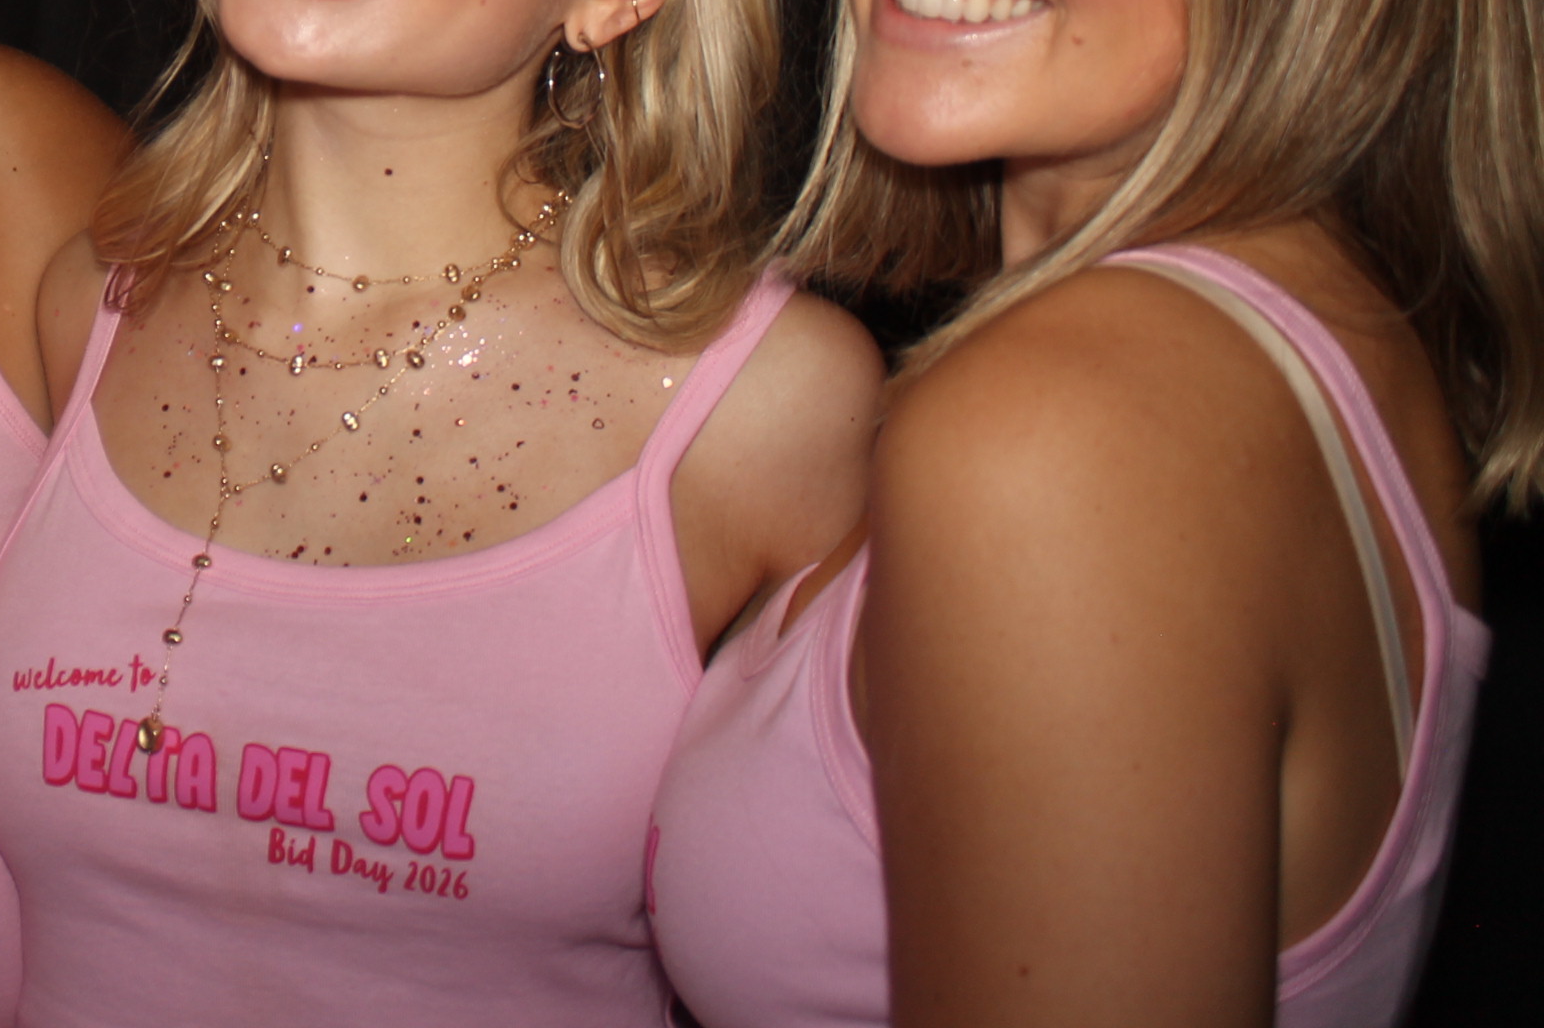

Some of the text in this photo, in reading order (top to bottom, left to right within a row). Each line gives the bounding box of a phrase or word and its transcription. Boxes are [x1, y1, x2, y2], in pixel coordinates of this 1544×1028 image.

[13, 654, 156, 692] welcome to
[42, 702, 475, 860] DELTA DEL SOL
[268, 828, 470, 902] Bid Day 2026
